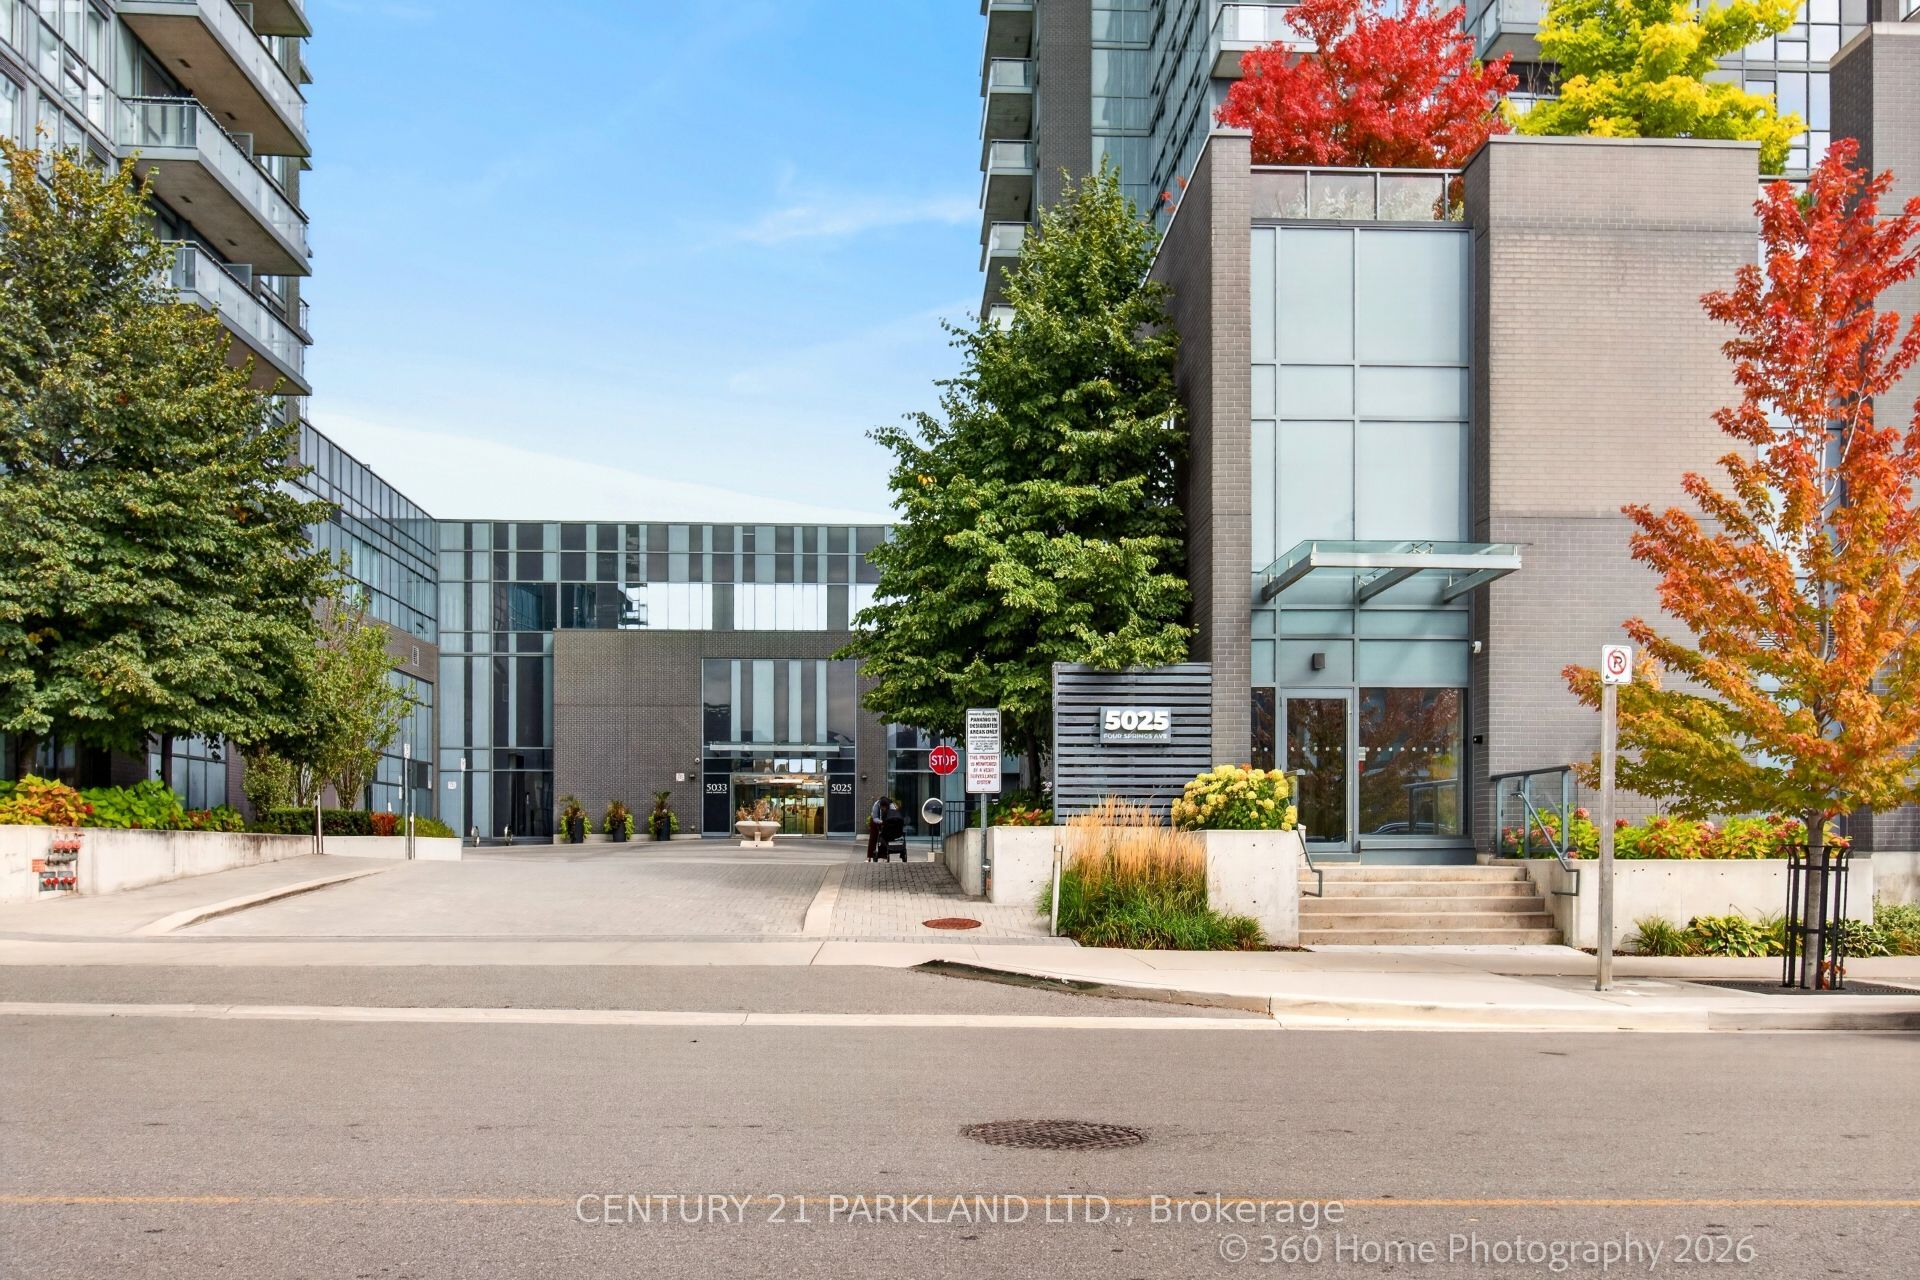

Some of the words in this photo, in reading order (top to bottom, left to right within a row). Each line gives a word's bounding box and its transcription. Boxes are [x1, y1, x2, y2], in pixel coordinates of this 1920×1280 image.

[1104, 710, 1169, 731] 5025
[931, 755, 956, 766] STOP
[706, 783, 728, 792] 5033
[831, 783, 852, 792] 5025
